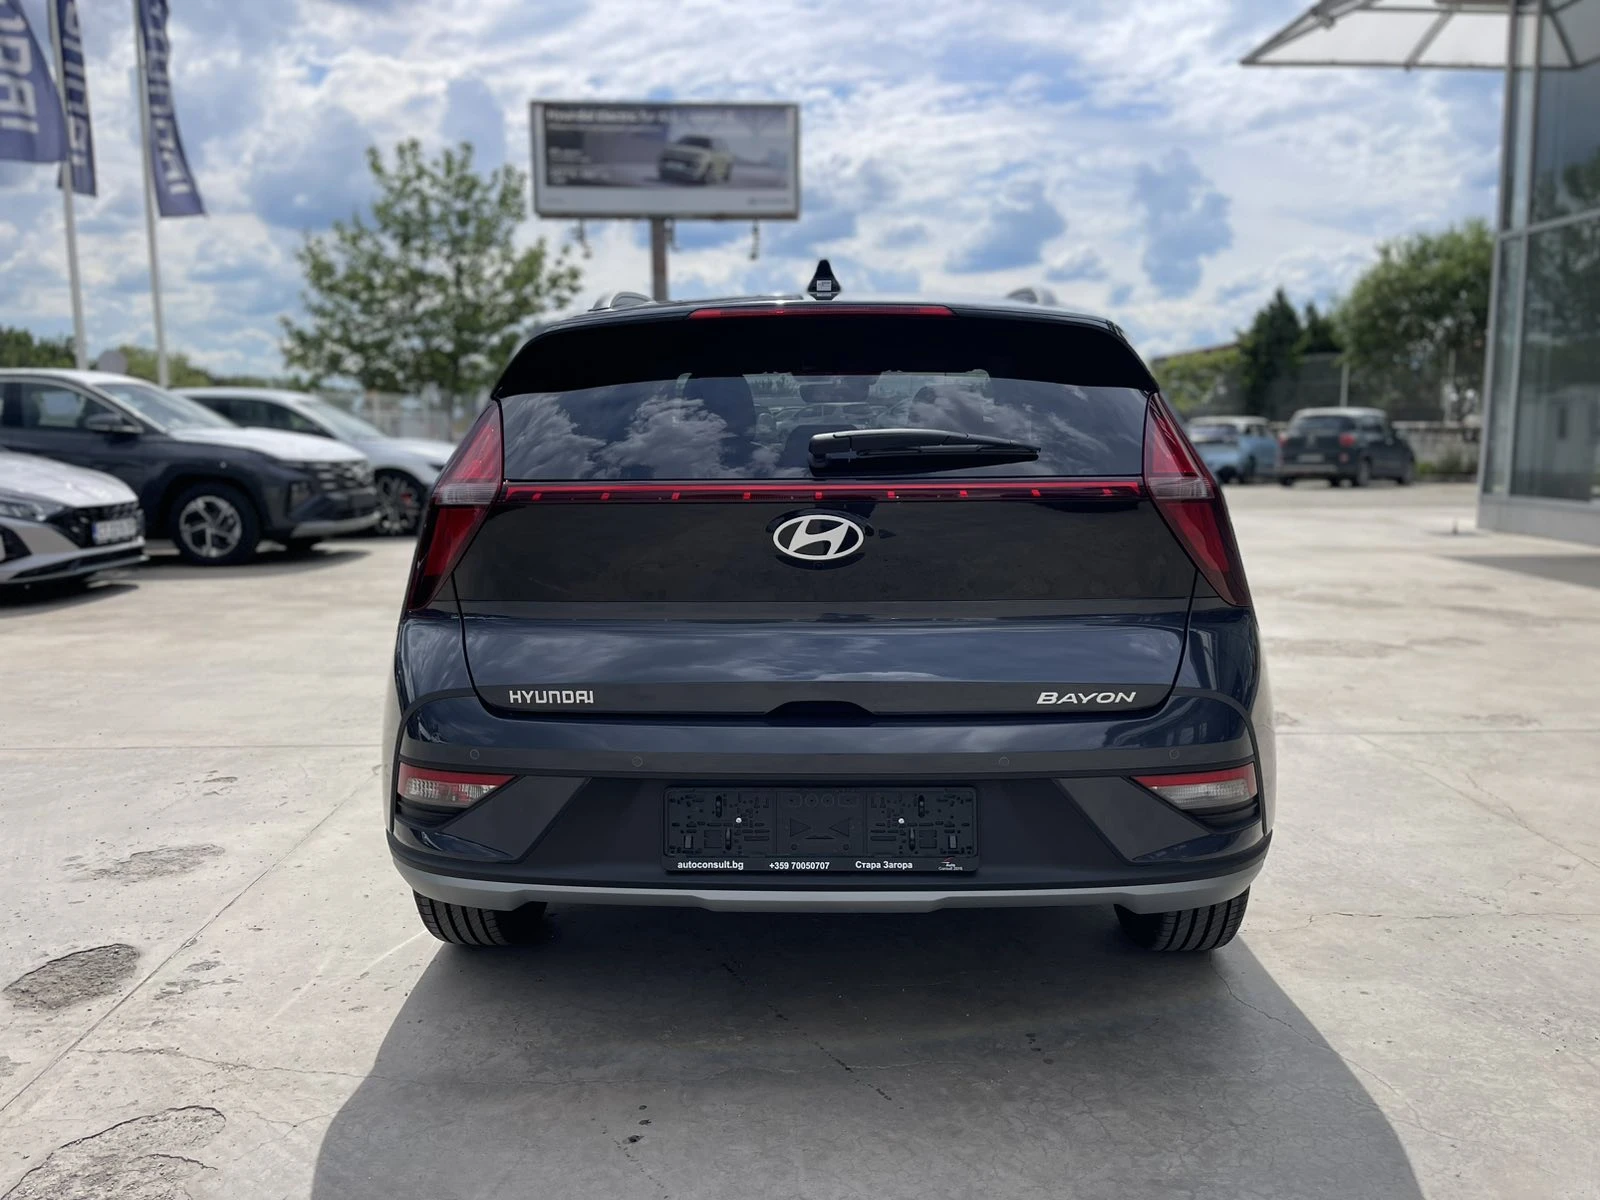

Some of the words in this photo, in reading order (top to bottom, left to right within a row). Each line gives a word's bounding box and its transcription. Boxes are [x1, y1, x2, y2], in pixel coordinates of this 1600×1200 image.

[509, 690, 594, 704] HYUNDAI
[1036, 692, 1136, 704] BAYON
[677, 860, 744, 871] autoconsult.bg
[769, 861, 789, 870] +359
[791, 861, 830, 870] 70050707
[855, 860, 881, 870] Стара
[883, 860, 913, 870] Загора
